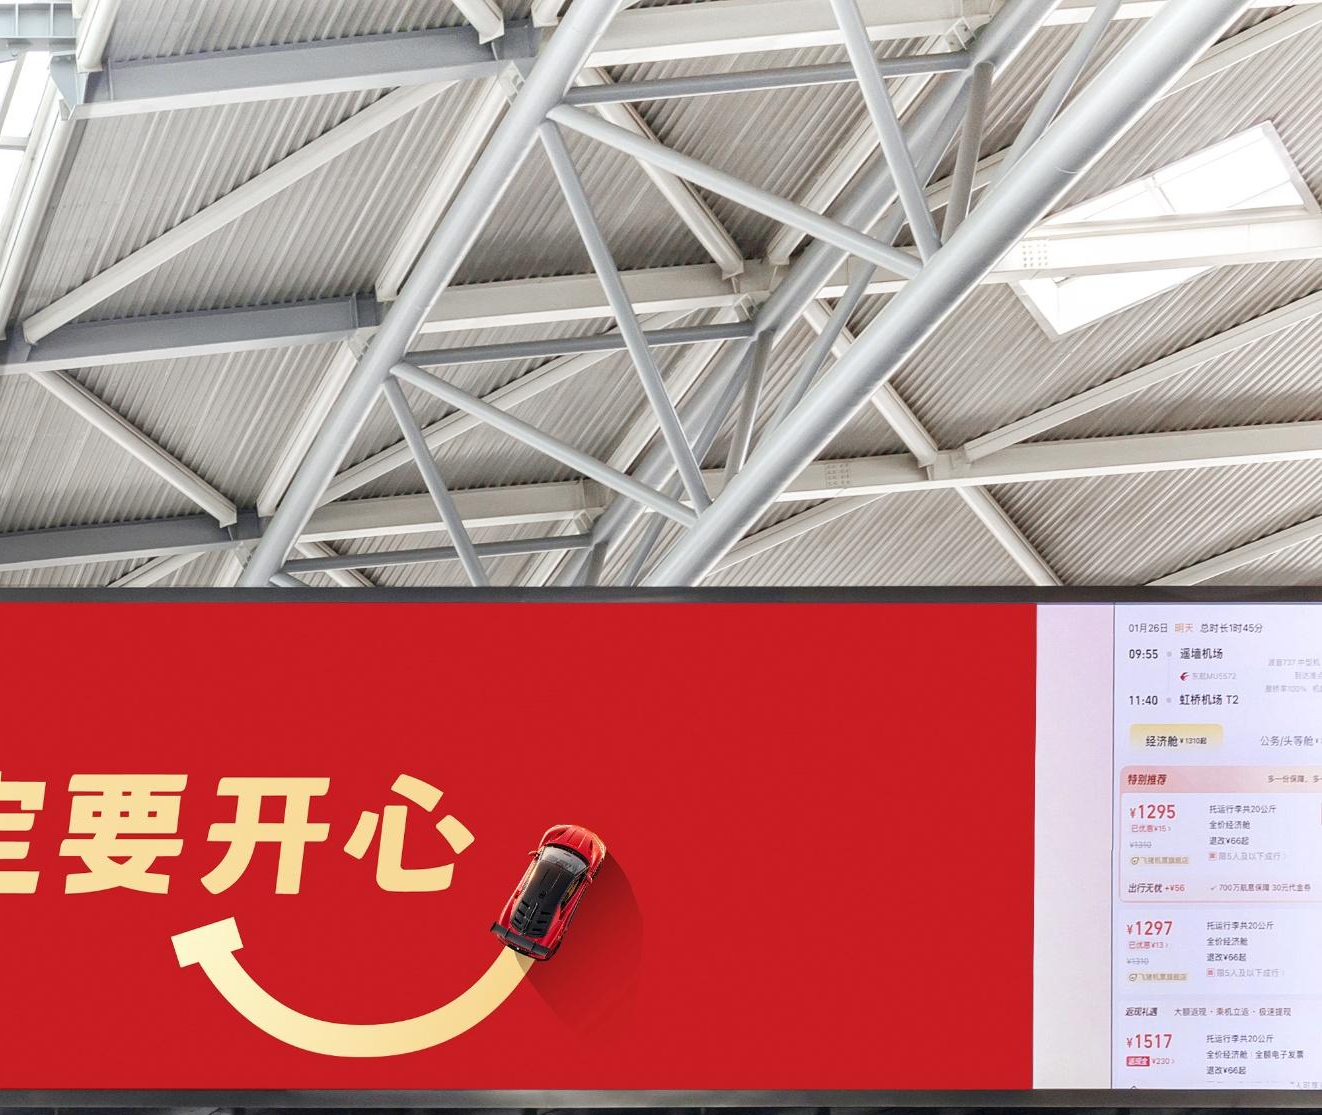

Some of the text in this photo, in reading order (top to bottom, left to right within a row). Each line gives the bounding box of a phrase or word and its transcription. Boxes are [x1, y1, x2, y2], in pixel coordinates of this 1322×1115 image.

[1128, 623, 1168, 633] 01月26日
[1129, 649, 1159, 659] 09:55
[1129, 694, 1239, 706] 11:40 虹桥机场 T2
[1127, 774, 1167, 785] 特别推荐
[1129, 804, 1176, 819] ¥1295
[1126, 921, 1173, 936] ¥1297
[1126, 1034, 1173, 1049] ¥1517
